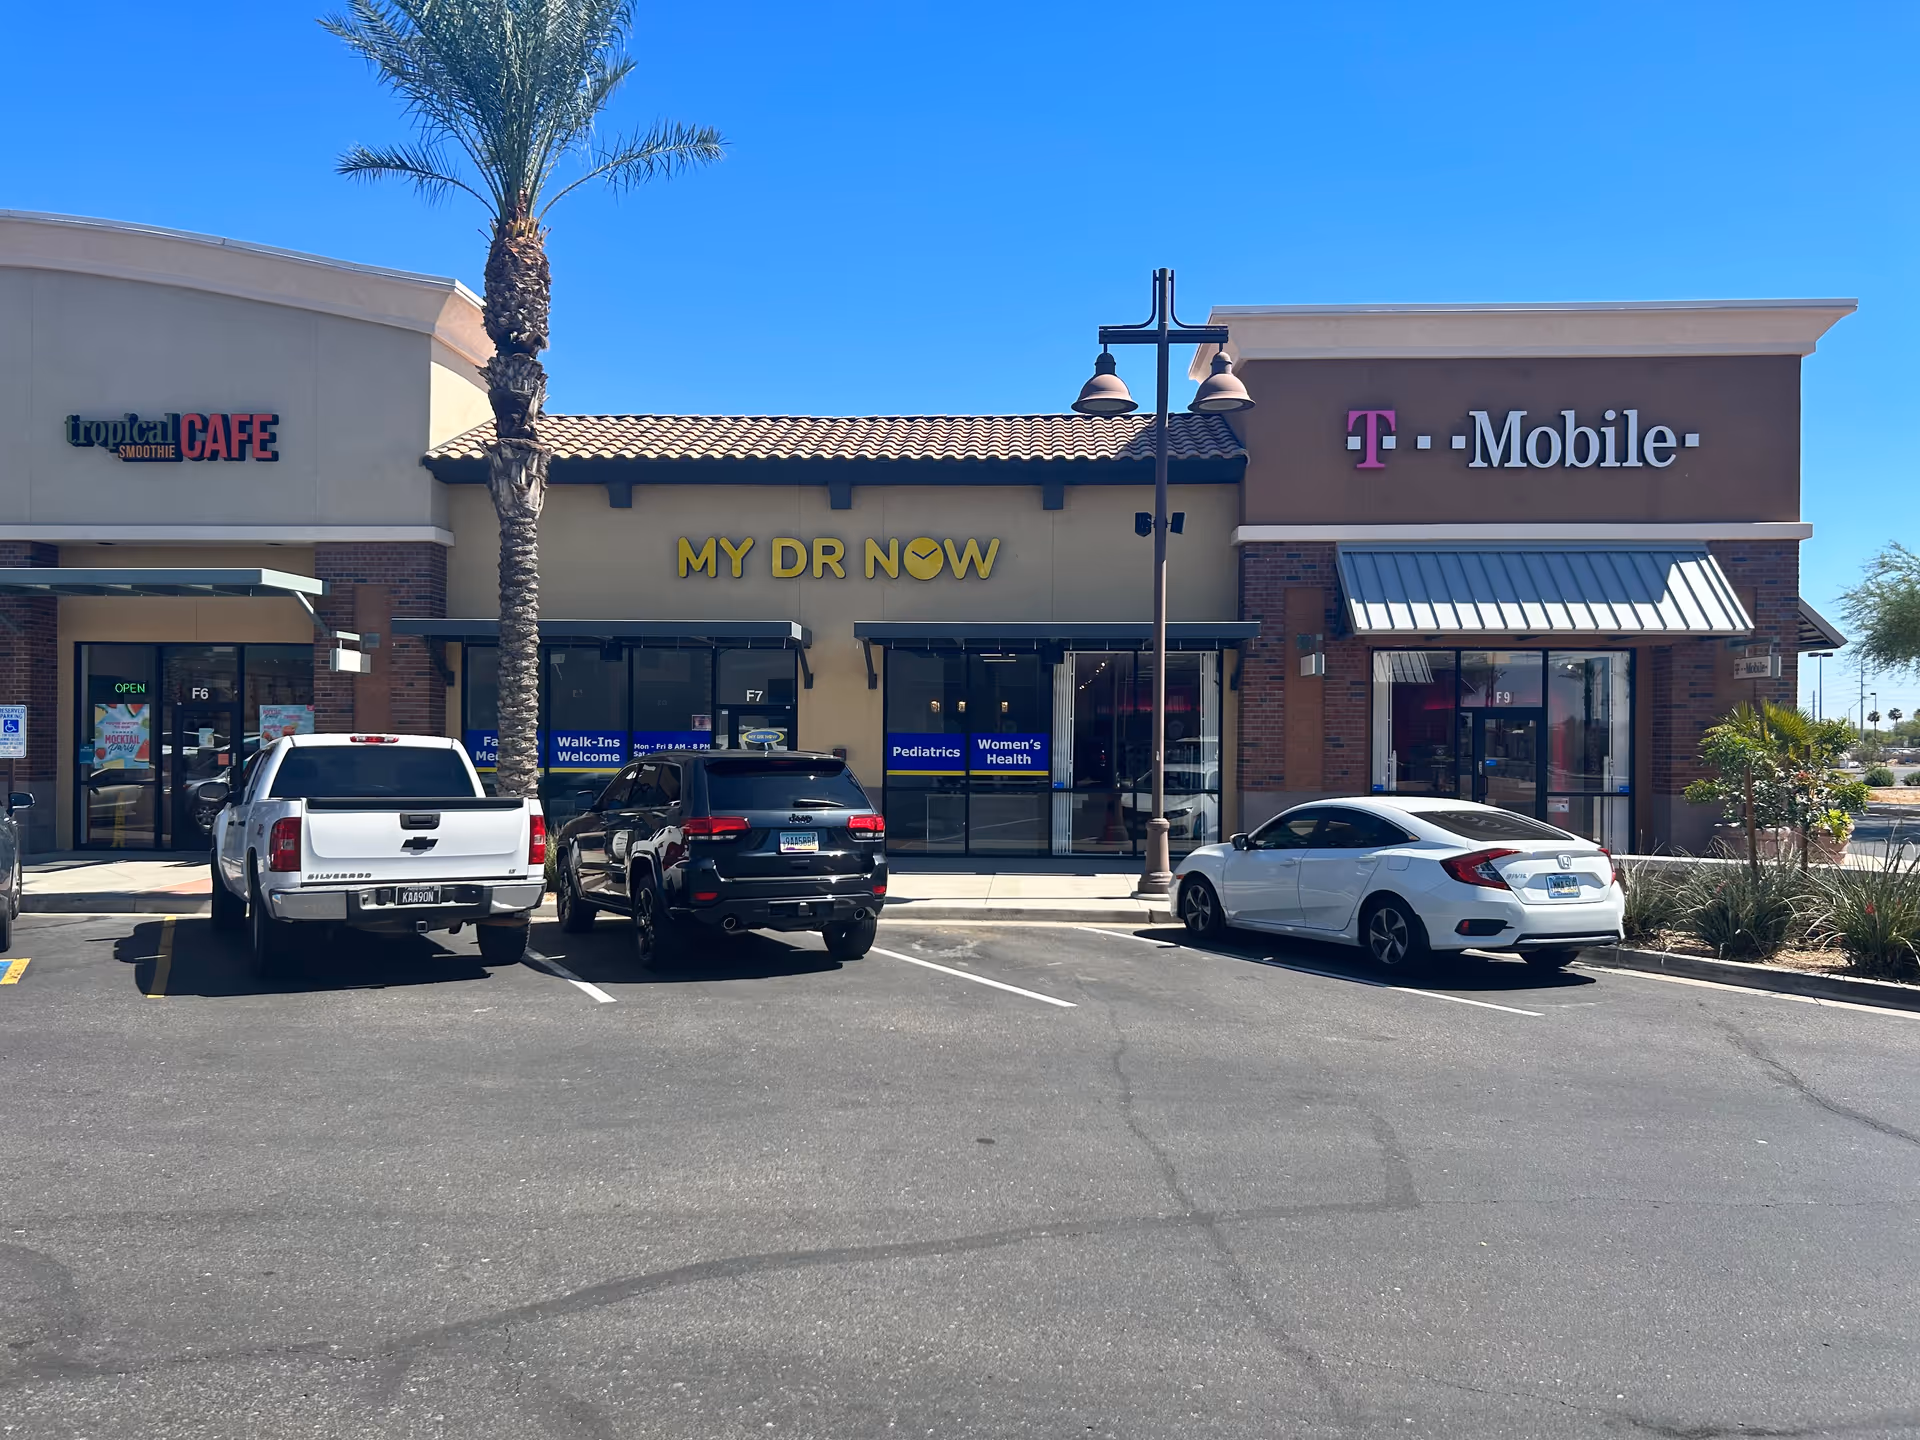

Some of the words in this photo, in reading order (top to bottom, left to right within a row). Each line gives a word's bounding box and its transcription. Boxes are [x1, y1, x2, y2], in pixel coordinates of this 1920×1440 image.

[64, 412, 176, 449] tropical
[180, 412, 273, 460] CAFE
[119, 445, 176, 458] SMOOTHIE
[677, 536, 755, 579] MY
[771, 536, 847, 579] DR
[864, 536, 1001, 581] NOW
[114, 682, 146, 694] OPEN
[191, 687, 209, 700] F6
[746, 689, 763, 702] F7
[1496, 691, 1511, 704] F9
[104, 734, 140, 744] MOCKTAIL
[557, 736, 621, 748] Walk-Ins
[977, 737, 1042, 751] Women's
[557, 751, 620, 762] Welcome
[892, 745, 961, 759] Pediatrics
[986, 752, 1032, 765] Health
[307, 872, 372, 880] SILVERADO
